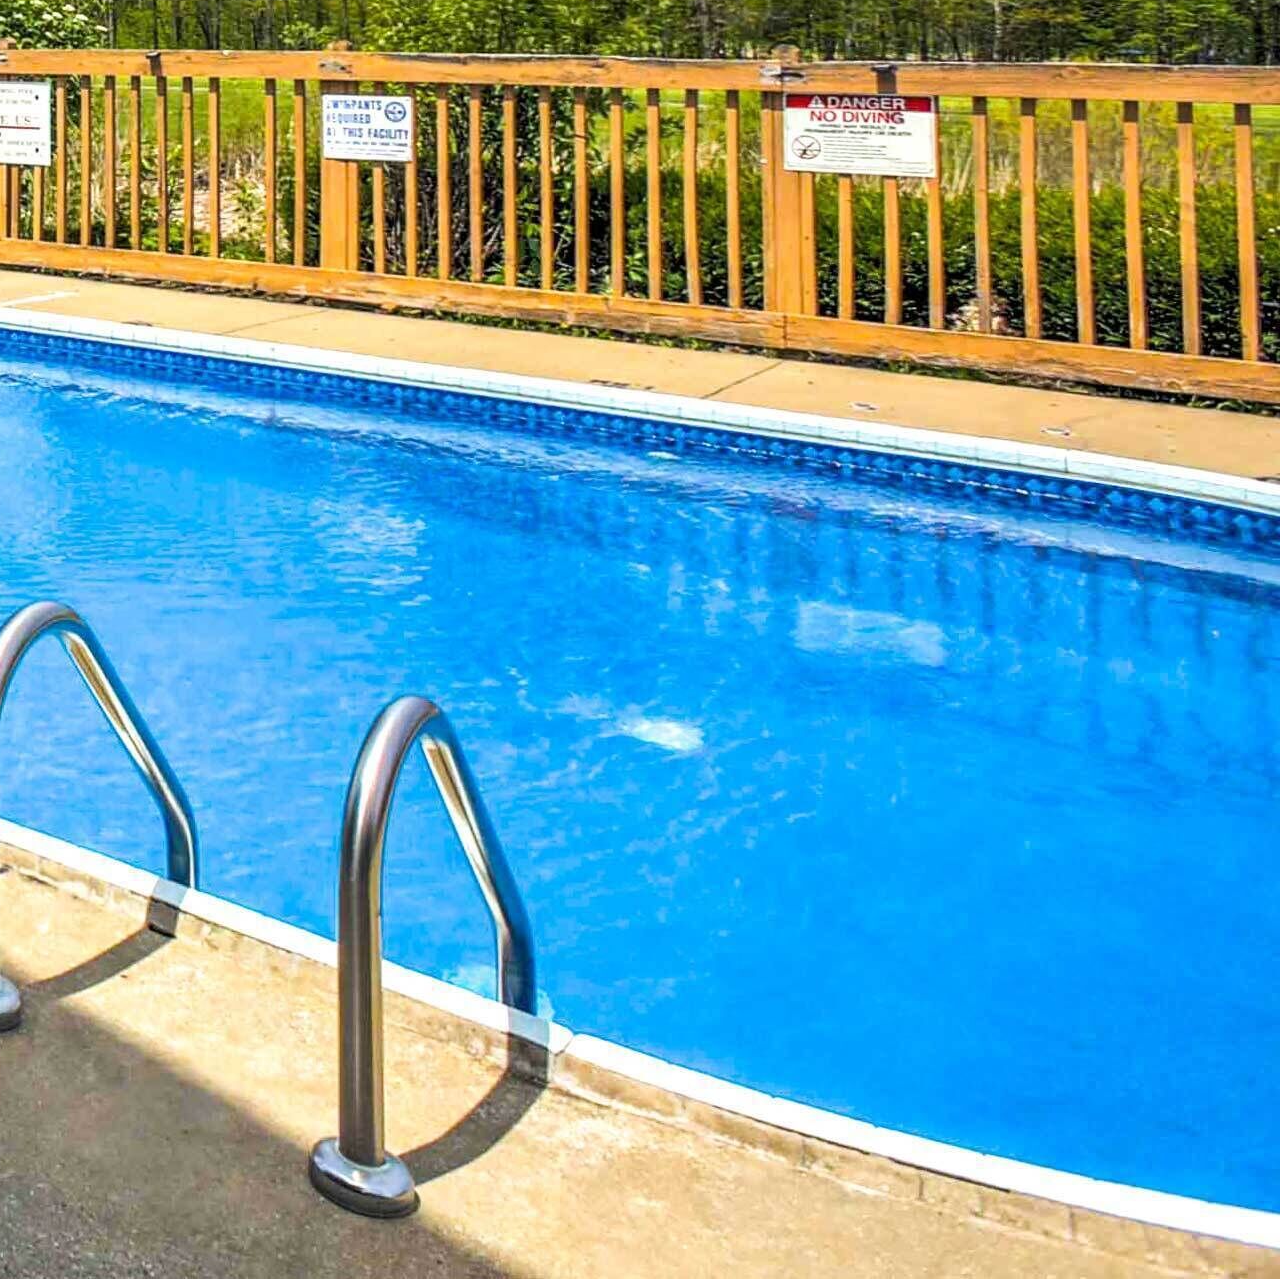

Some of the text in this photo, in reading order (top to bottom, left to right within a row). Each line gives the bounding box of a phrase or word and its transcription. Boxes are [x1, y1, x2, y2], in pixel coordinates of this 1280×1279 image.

[827, 96, 906, 110] DANGER
[809, 110, 905, 124] NO DIVING
[343, 127, 363, 138] THIS
[367, 128, 409, 139] FACILITY
